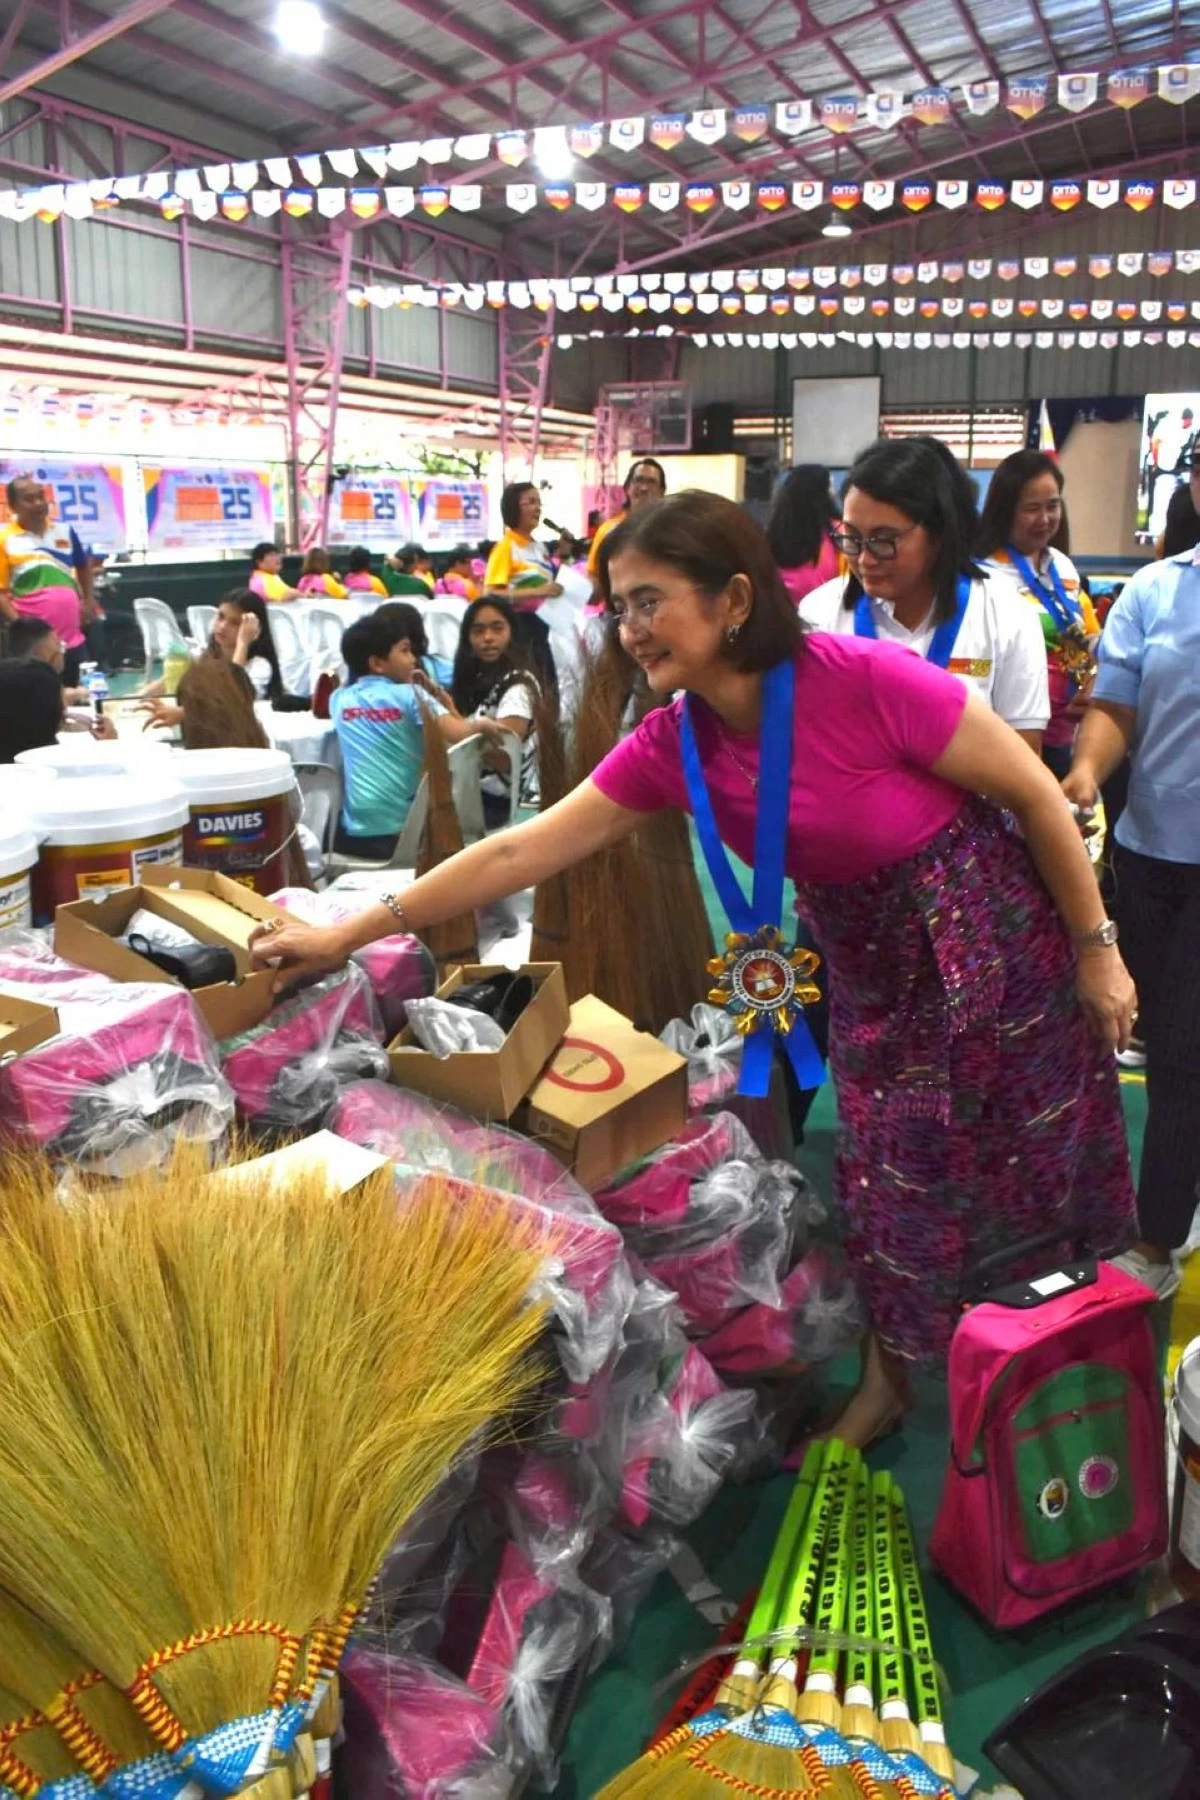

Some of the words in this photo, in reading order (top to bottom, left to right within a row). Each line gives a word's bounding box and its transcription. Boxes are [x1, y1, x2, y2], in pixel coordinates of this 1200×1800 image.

[758, 186, 784, 196] DITO
[832, 185, 859, 196] DITO
[903, 185, 931, 196] DITO
[977, 185, 1003, 196] DITO
[1052, 185, 1079, 195] DITO
[57, 484, 99, 521] 25
[221, 487, 252, 520] 25
[373, 492, 396, 519] 25
[463, 495, 481, 519] 25
[198, 812, 263, 833] DAVIES
[875, 1493, 888, 1554] CITY
[854, 1559, 867, 1682] BGUIO
